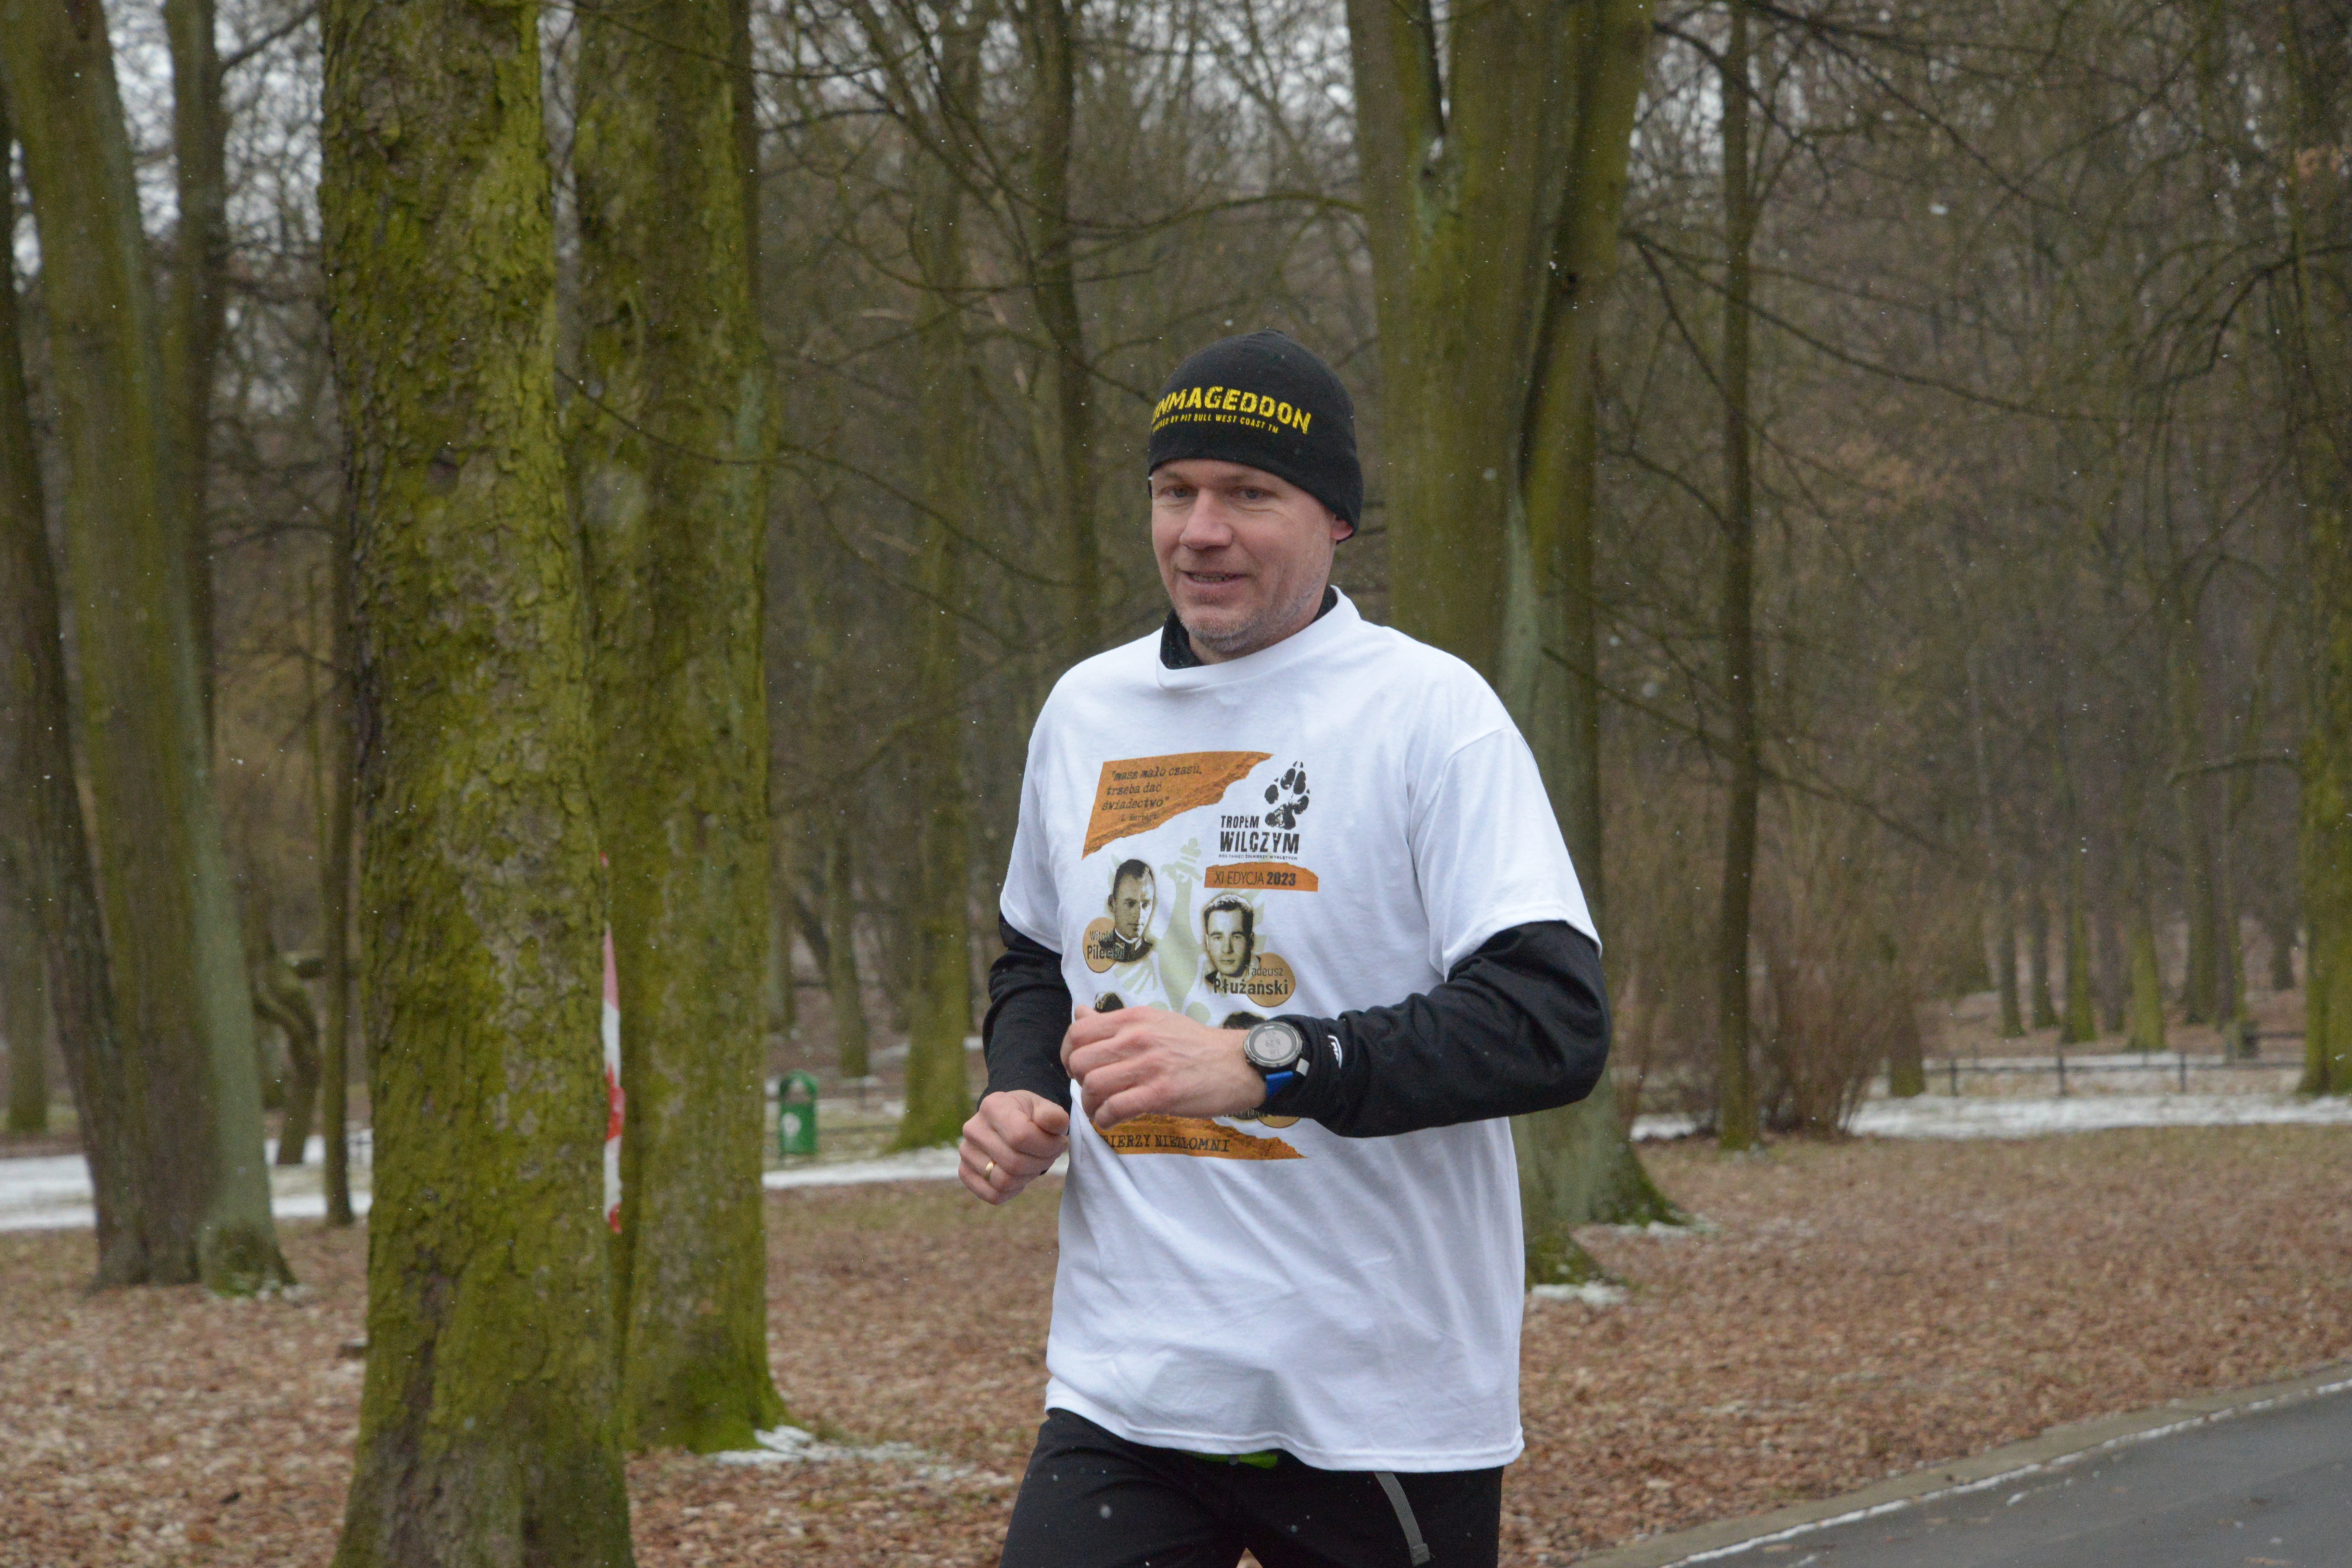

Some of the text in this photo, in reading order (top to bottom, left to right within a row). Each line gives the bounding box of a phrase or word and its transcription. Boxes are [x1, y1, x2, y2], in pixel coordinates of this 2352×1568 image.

[1216, 414, 1237, 423] WEST
[1240, 417, 1265, 428] COAST
[1268, 424, 1279, 434] TM
[1107, 783, 1140, 795] trzeba
[1221, 815, 1259, 828] TROPEM
[1220, 831, 1300, 854] WILCZYM
[1214, 871, 1296, 886] XI EDYCJA 2023
[1246, 964, 1283, 976] Tadeusz
[1214, 978, 1288, 995] Płużański
